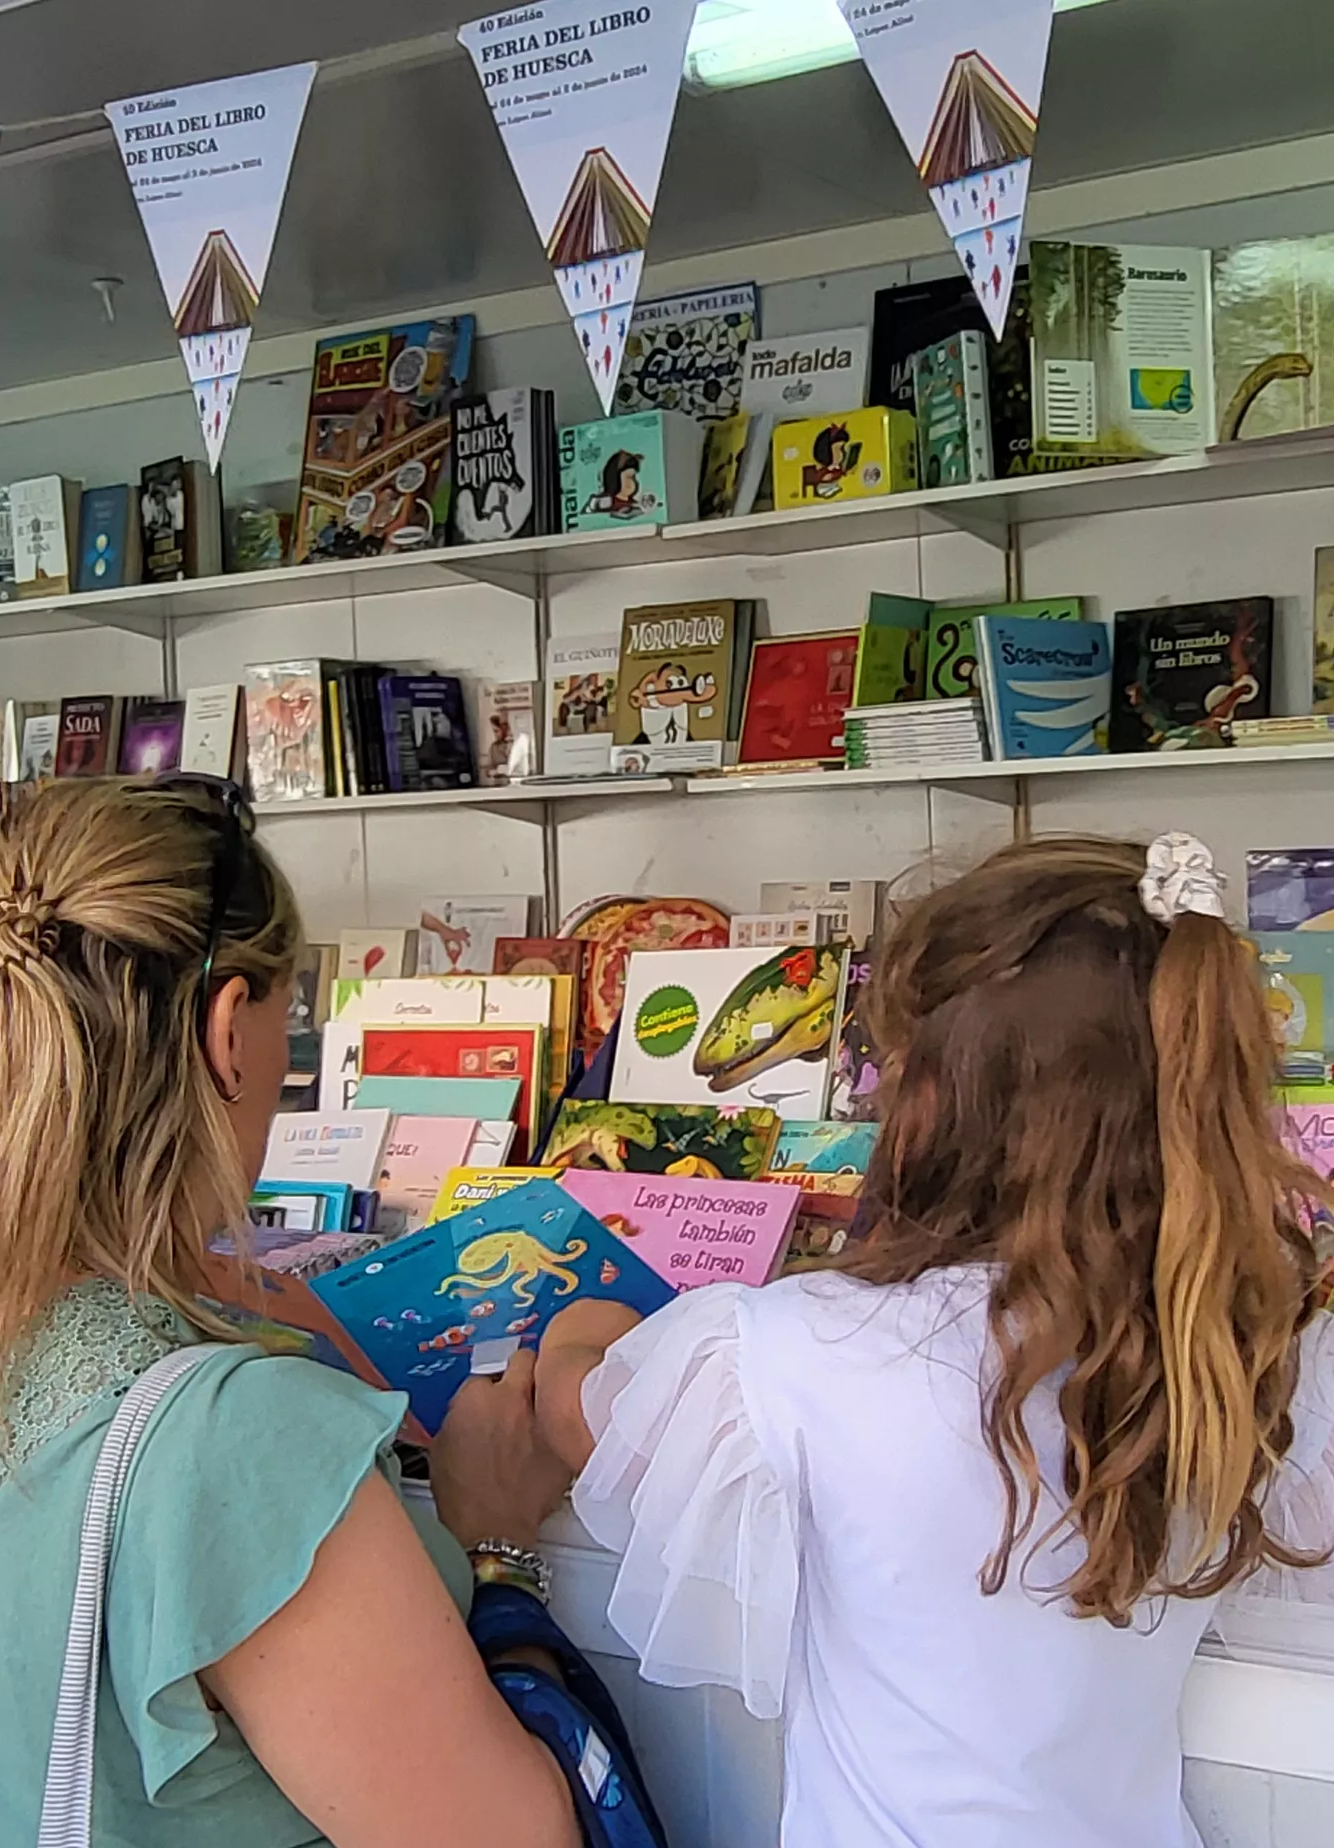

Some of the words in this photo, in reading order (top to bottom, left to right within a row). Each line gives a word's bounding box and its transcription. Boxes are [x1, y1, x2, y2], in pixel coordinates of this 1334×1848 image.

[479, 20, 494, 33] 40
[481, 34, 540, 63] FERIA
[544, 25, 585, 47] DEL
[589, 6, 650, 36] LIBRO
[484, 68, 508, 88] DE
[512, 48, 593, 81] HUESCA
[125, 121, 174, 143] FERIA
[178, 115, 211, 134] DEL
[214, 104, 266, 127] LIBRO
[126, 150, 147, 166] DE
[151, 138, 218, 162] HUESCA
[751, 347, 852, 380] mafalda
[457, 424, 507, 457] CUENTES
[457, 450, 513, 487] CUENTOS
[1150, 638, 1172, 652] Un
[1175, 631, 1230, 651] mundo
[1155, 654, 1176, 669] sin
[1179, 651, 1221, 667] libros
[641, 1004, 694, 1028] Contiene
[454, 1183, 494, 1199] Dani
[634, 1186, 668, 1209] Las
[666, 1193, 768, 1217] princesas
[679, 1220, 756, 1245] también
[670, 1252, 692, 1269] se
[695, 1249, 744, 1275] tiran
